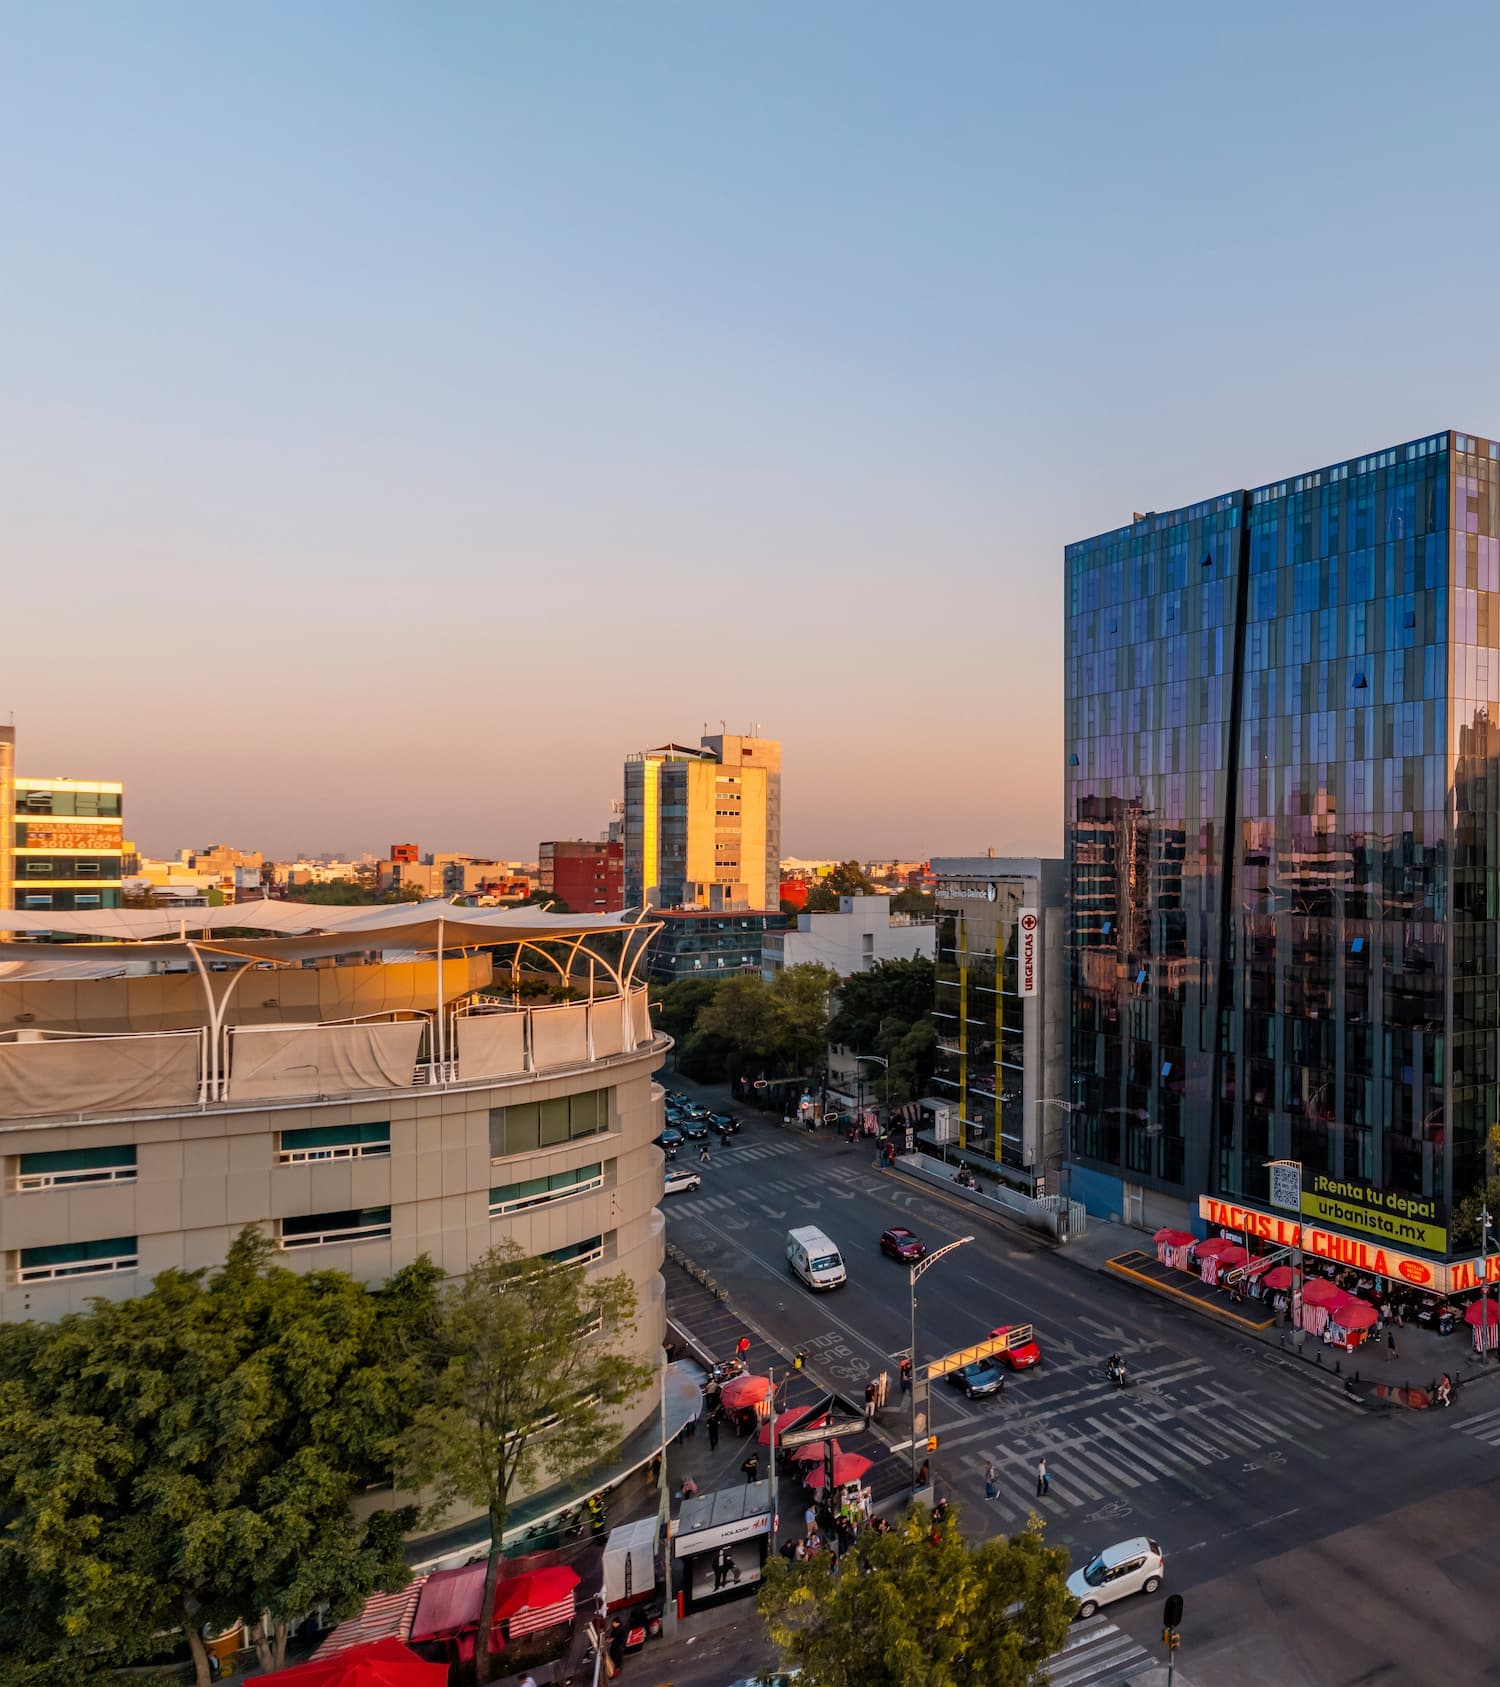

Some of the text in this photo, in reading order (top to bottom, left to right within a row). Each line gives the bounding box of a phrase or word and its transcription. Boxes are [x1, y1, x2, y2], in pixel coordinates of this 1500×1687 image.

[1025, 933, 1033, 991] URGENCIAS
[1314, 1175, 1436, 1219] ¡Renta tu depa!
[1207, 1200, 1272, 1239] TACOS
[1277, 1220, 1303, 1249] LA
[1312, 1231, 1389, 1276] CHULA
[1318, 1201, 1426, 1243] urbanista.mx
[813, 1344, 854, 1366] BUS
[720, 1526, 750, 1537] HOLIDAY
